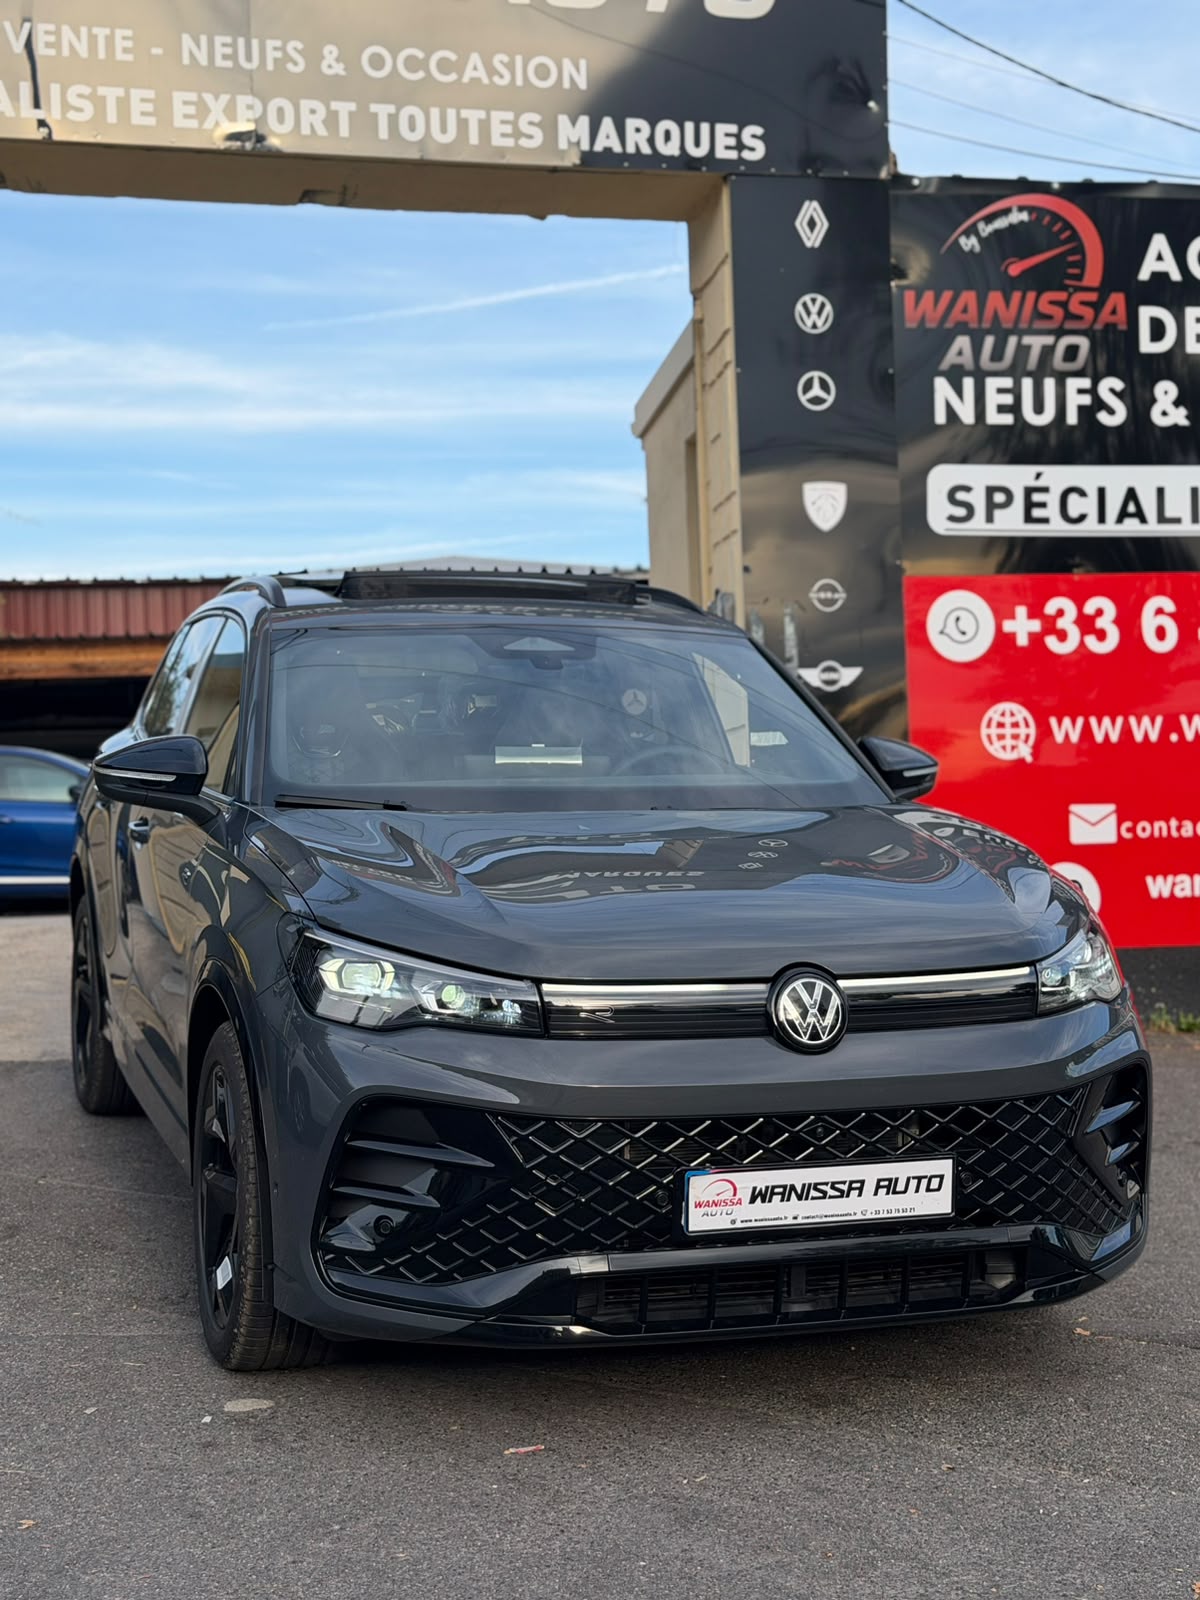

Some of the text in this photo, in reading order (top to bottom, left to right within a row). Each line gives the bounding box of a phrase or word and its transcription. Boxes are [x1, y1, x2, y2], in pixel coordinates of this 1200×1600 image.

[3, 21, 134, 62] VENTE
[181, 33, 306, 74] NEUFS
[321, 47, 347, 76] &
[361, 45, 589, 91] OCCASION
[173, 90, 357, 138] EXPORT
[370, 103, 544, 149] TOUTES
[557, 114, 766, 161] MARQUES
[904, 289, 1128, 330] WANISSA
[938, 335, 1091, 371] AUTO
[934, 376, 1190, 427] NEUFS &
[946, 472, 1199, 525] SPÉCIALI
[1002, 595, 1179, 654] +33 6
[694, 1198, 742, 1209] WANISSA
[748, 1173, 945, 1204] WANISSA AUTO
[701, 1208, 734, 1218] AUTO
